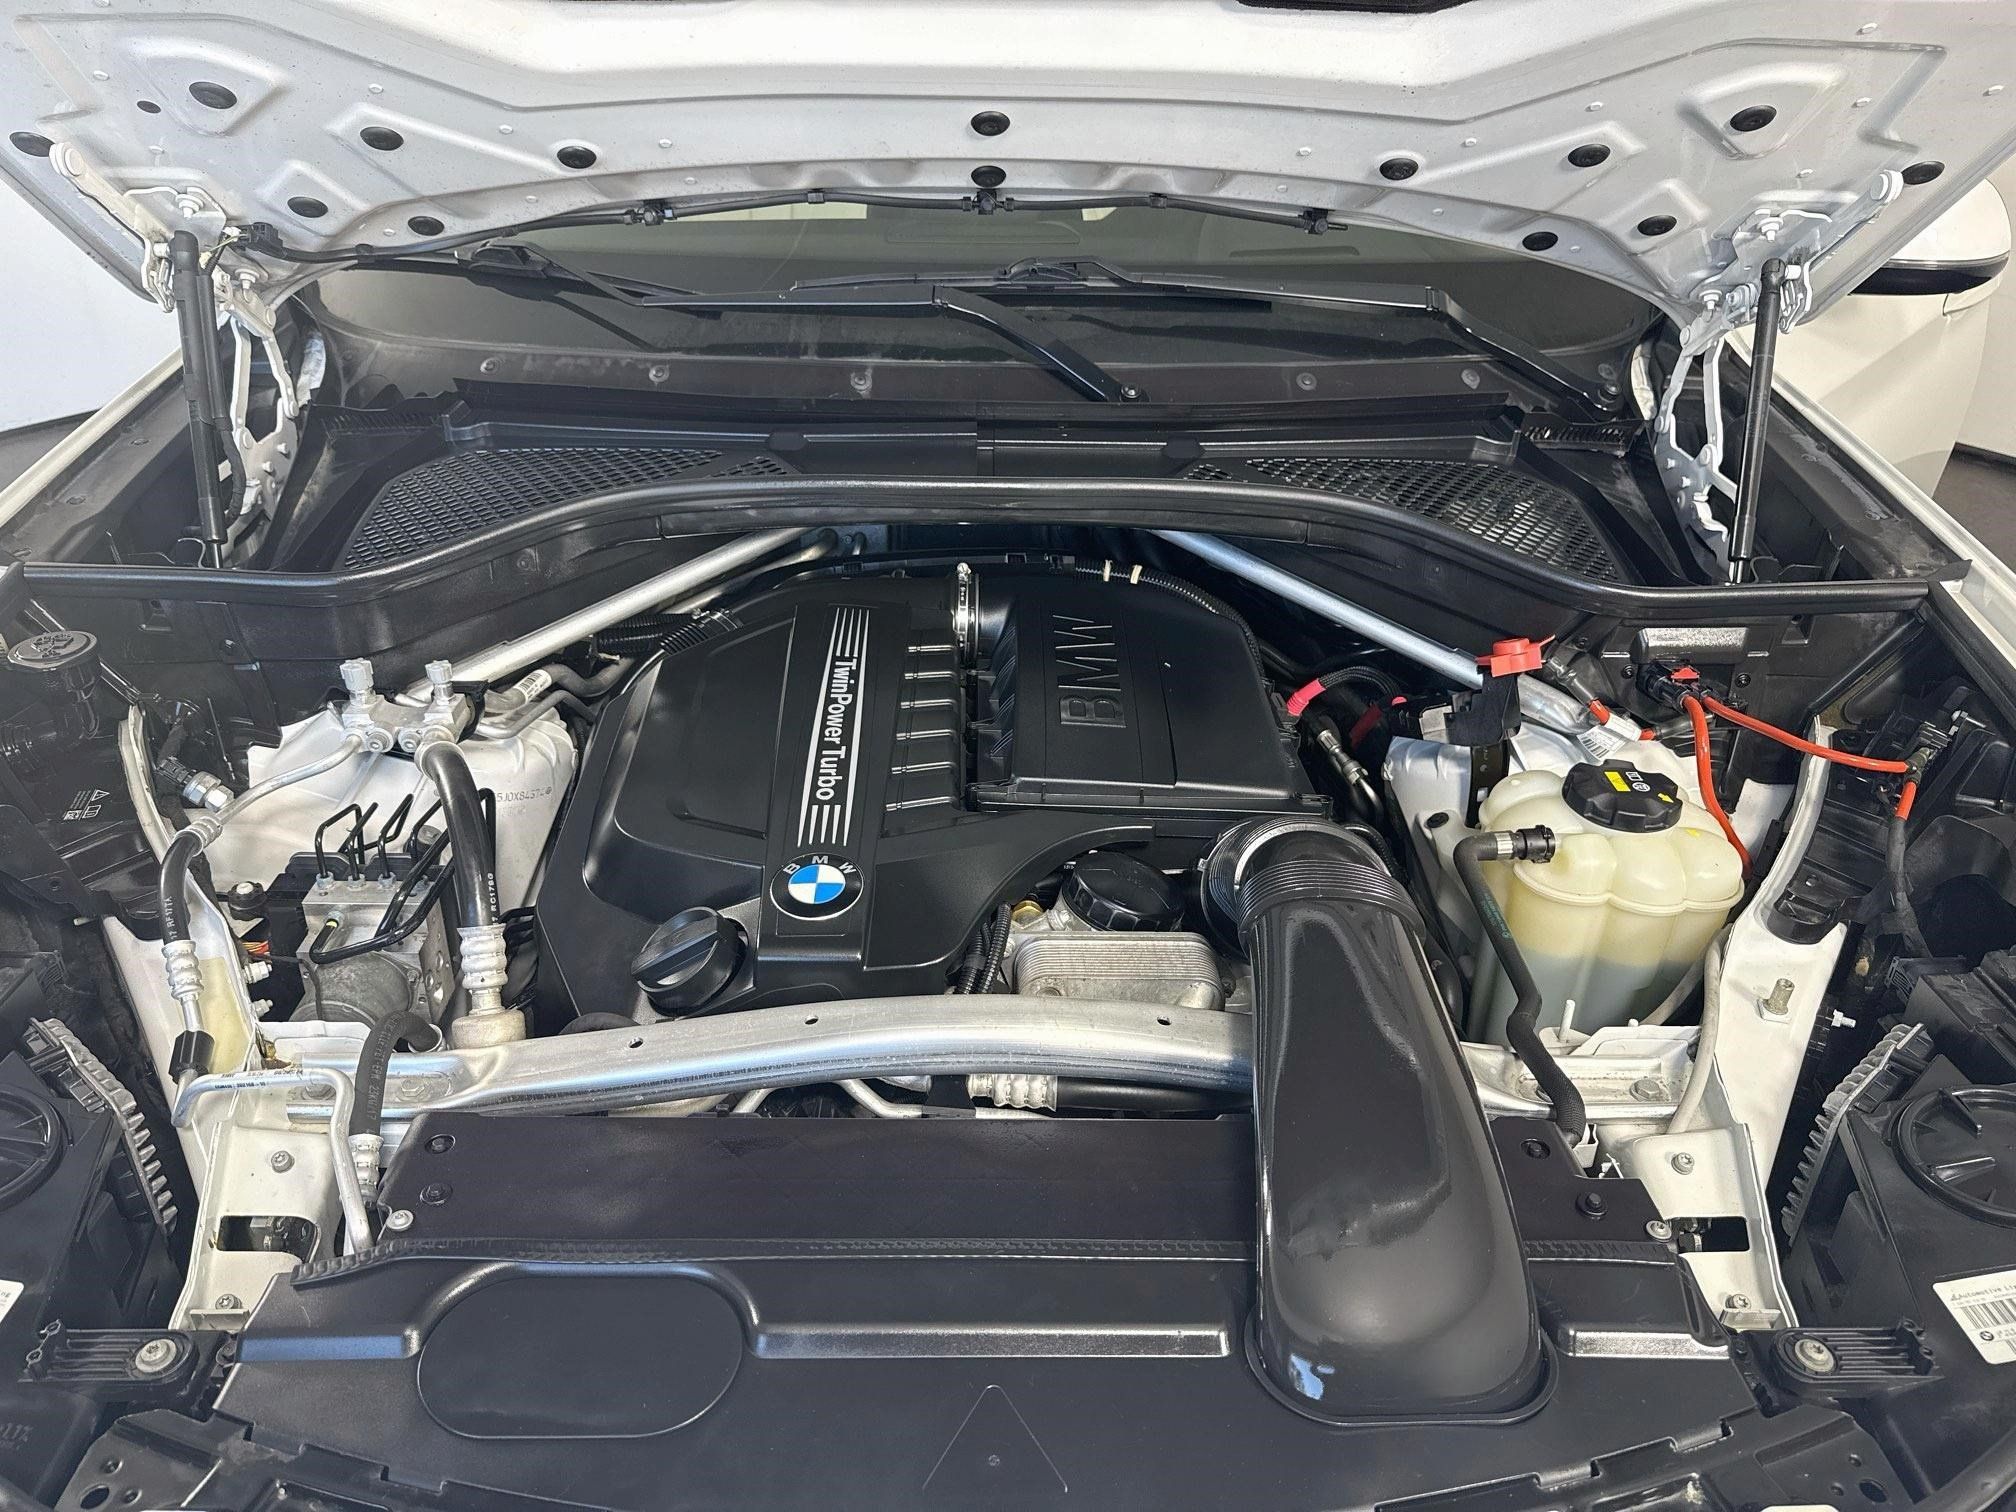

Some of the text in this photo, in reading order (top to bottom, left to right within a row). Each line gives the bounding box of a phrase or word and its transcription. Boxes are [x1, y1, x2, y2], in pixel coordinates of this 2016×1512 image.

[1052, 614, 1126, 729] BMW
[815, 658, 857, 801] TwinPower Turbo
[783, 855, 857, 875] BMW
